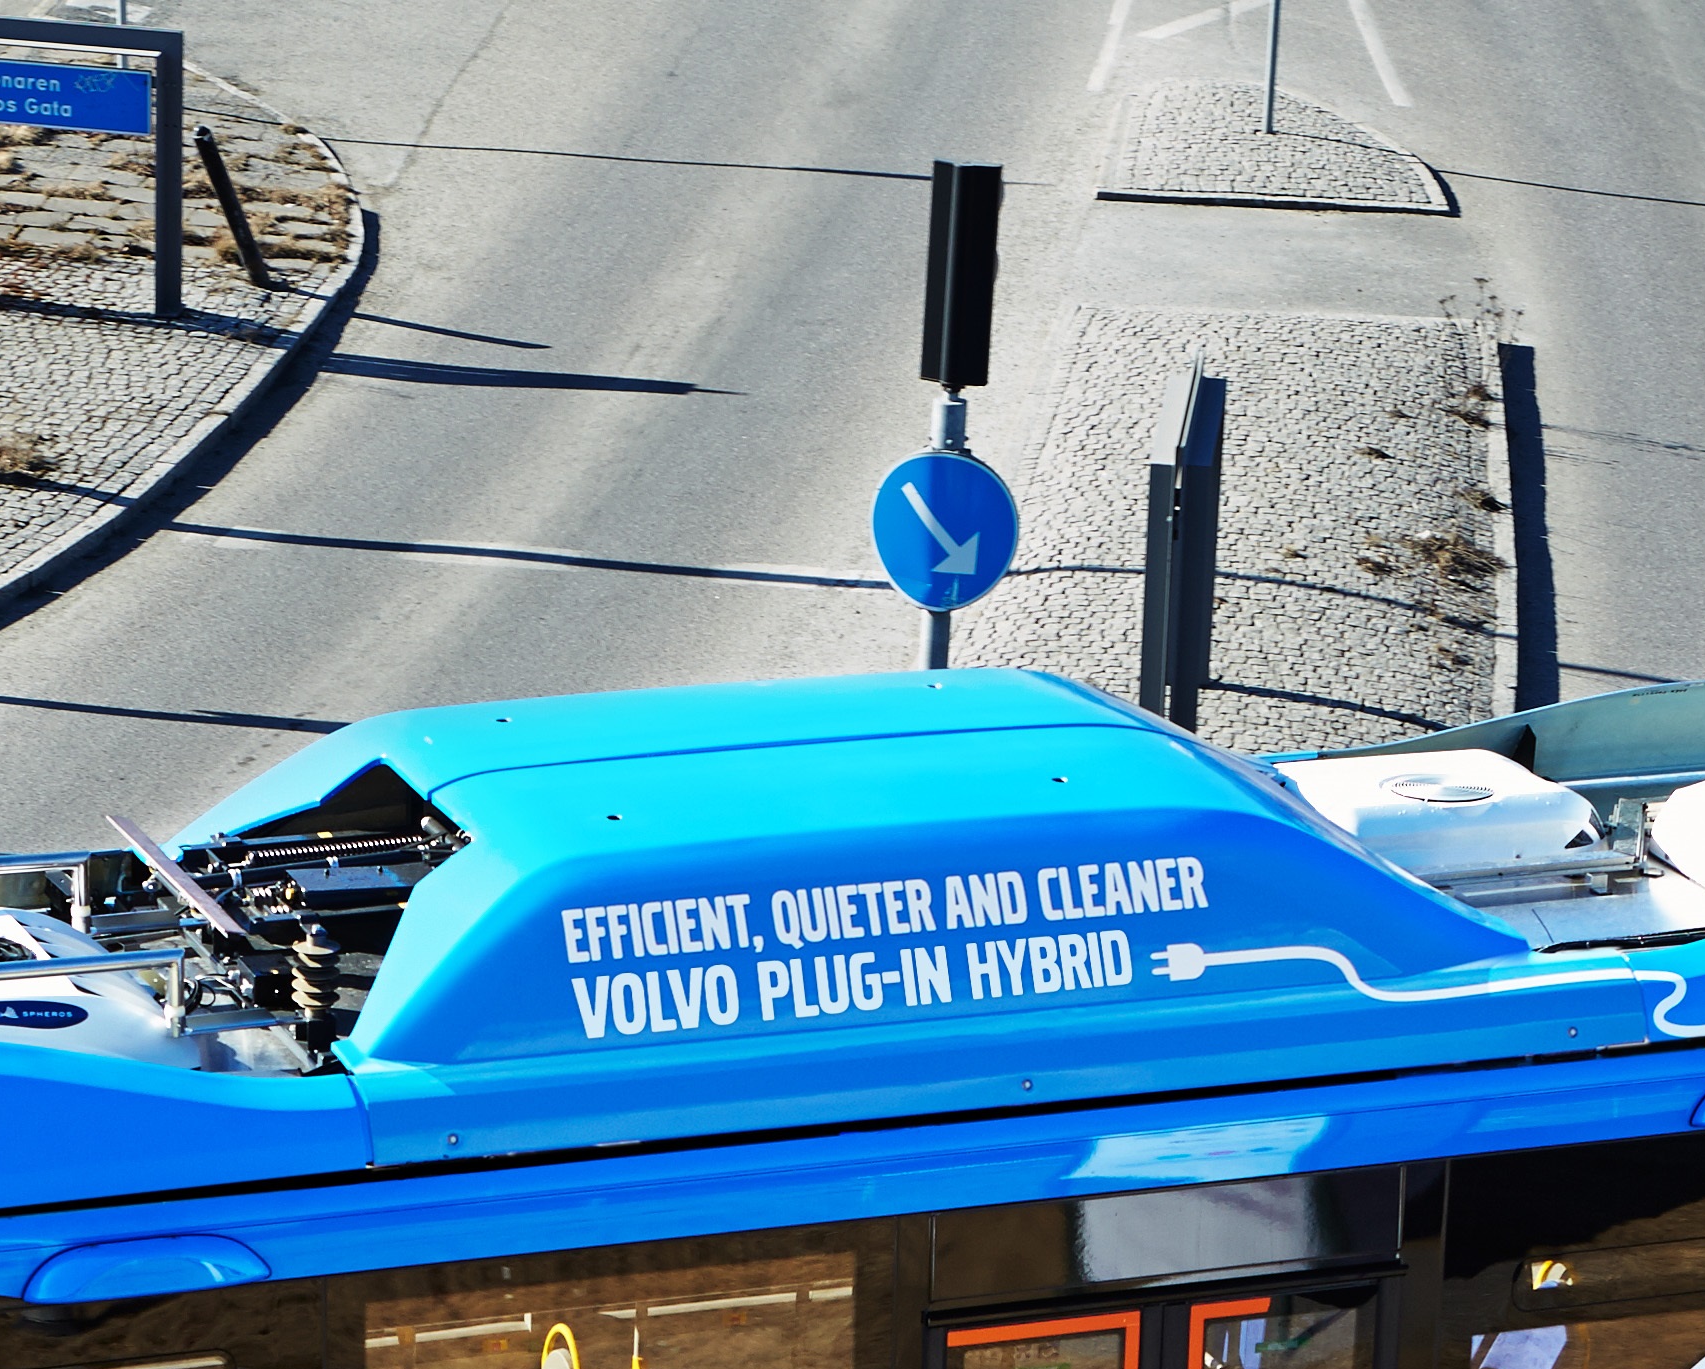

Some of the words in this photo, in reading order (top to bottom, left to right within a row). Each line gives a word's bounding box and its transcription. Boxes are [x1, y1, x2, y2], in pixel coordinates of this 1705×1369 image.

[24, 98, 72, 117] Gata
[561, 893, 764, 965] EFFICIENT,
[773, 878, 935, 949] QUIETER
[945, 870, 1028, 931] AND
[1039, 856, 1209, 922] CLEANER
[571, 963, 740, 1039] VOLVO
[758, 945, 952, 1022] PLUG-IN
[966, 929, 1134, 1000] HYBRID
